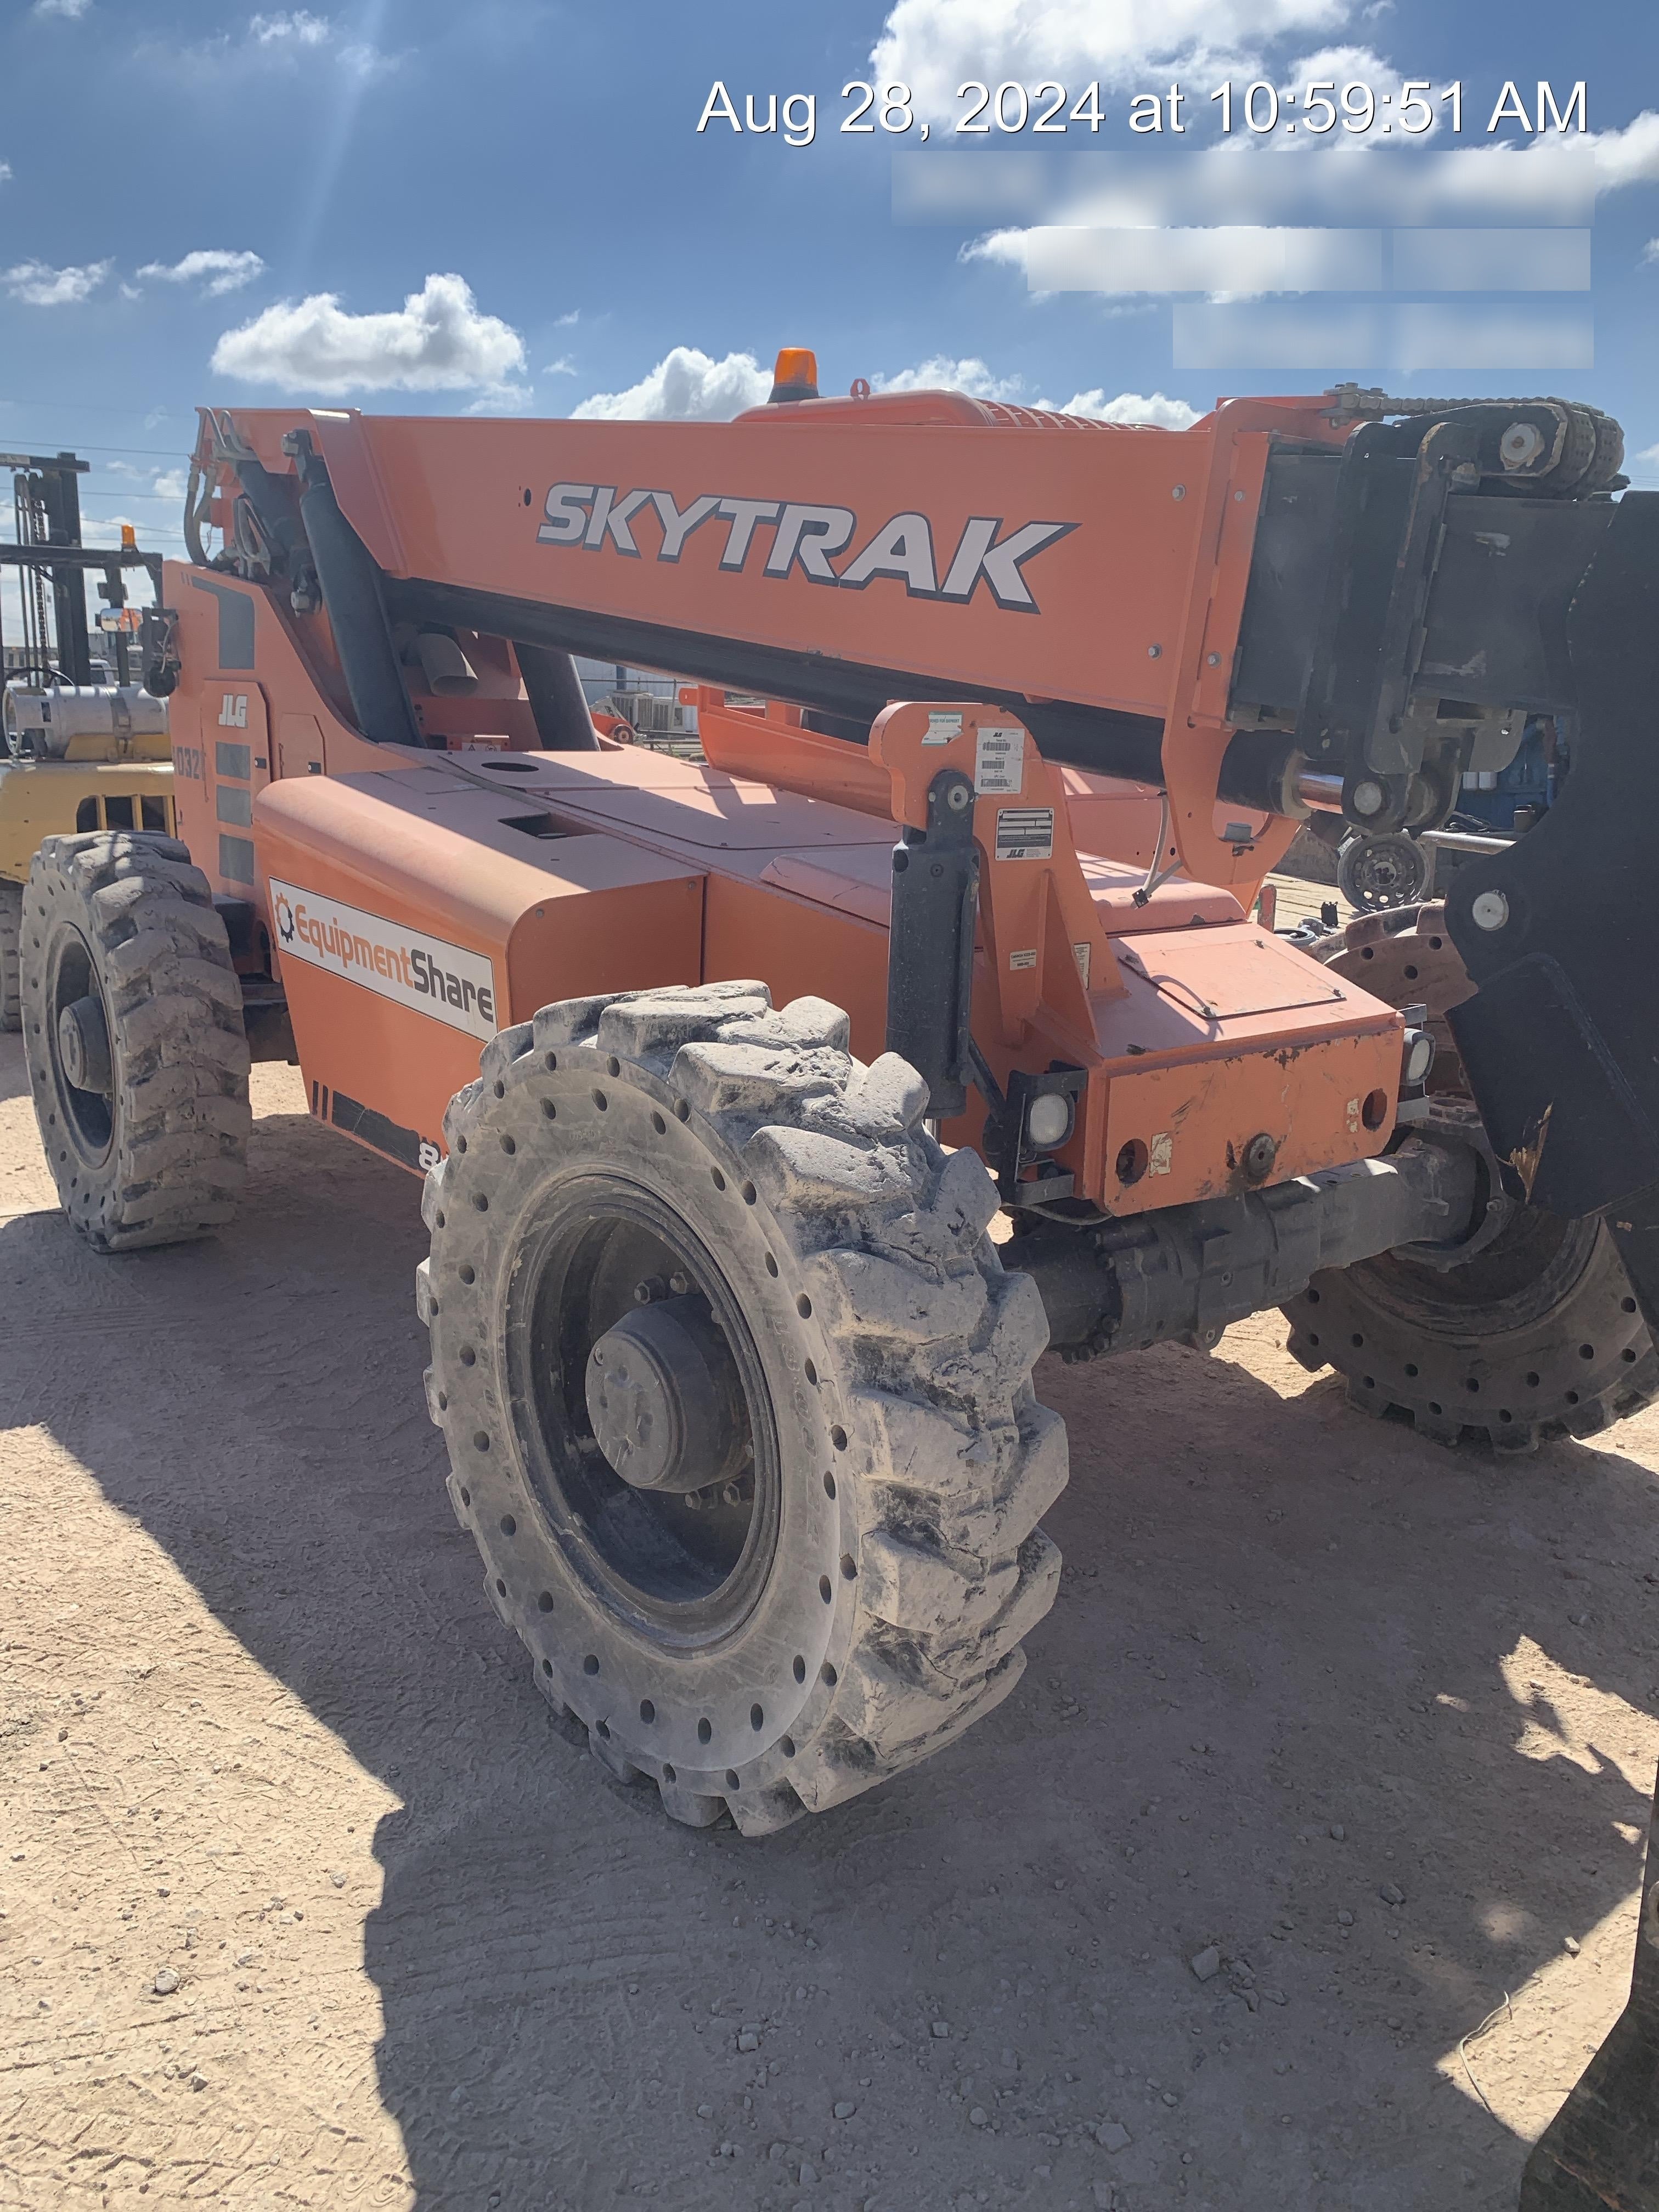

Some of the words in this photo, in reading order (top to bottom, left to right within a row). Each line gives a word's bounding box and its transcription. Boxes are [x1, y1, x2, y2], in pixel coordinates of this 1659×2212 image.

[537, 482, 1082, 615] SKYTRAK
[218, 693, 247, 728] JLG
[1006, 849, 1025, 859] JLG
[295, 904, 494, 1023] EquipmentShare
